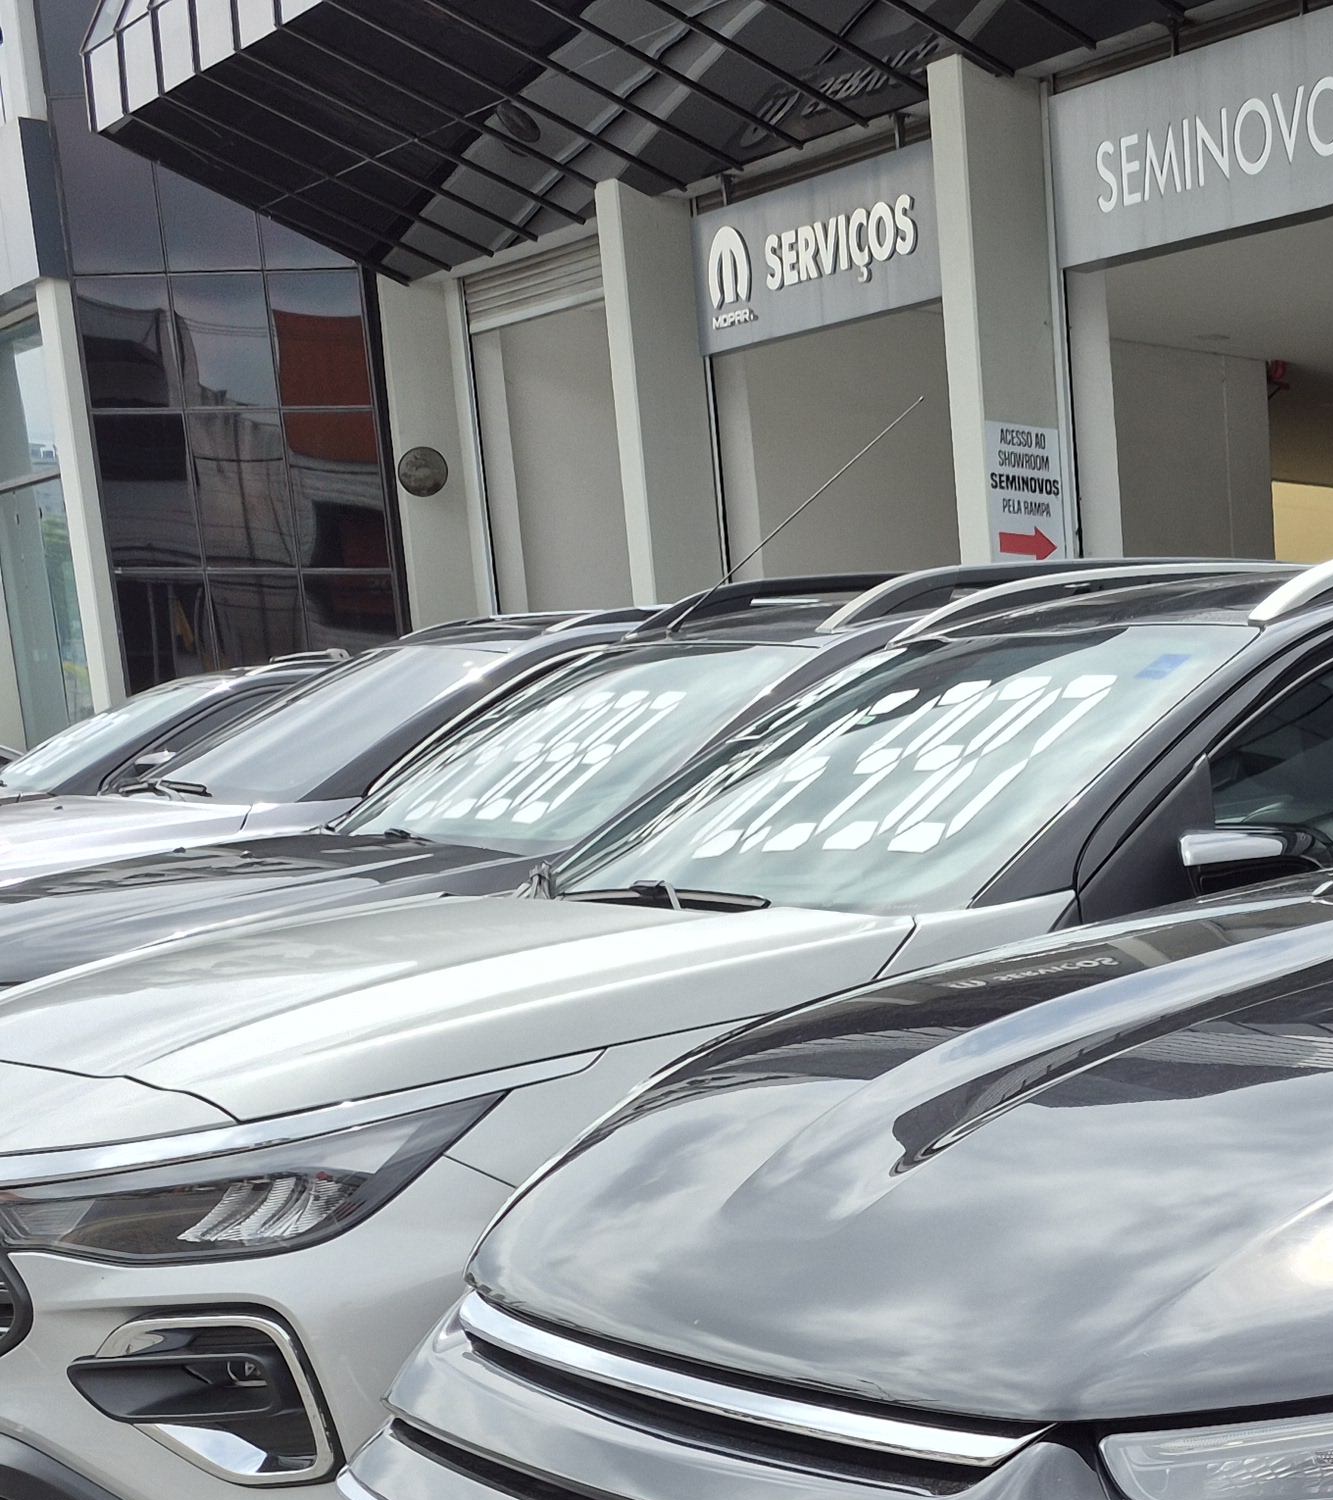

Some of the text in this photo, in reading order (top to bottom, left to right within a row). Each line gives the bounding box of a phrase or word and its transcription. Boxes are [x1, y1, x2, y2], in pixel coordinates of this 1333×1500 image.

[764, 194, 918, 291] SERVIÇOS
[712, 308, 753, 330] MOPAR
[1000, 428, 1046, 450] ACESSO AO
[998, 450, 1050, 472] SHOWROOM
[990, 472, 1060, 497] SEMINOVOS
[1002, 498, 1051, 517] PELA RAMPA
